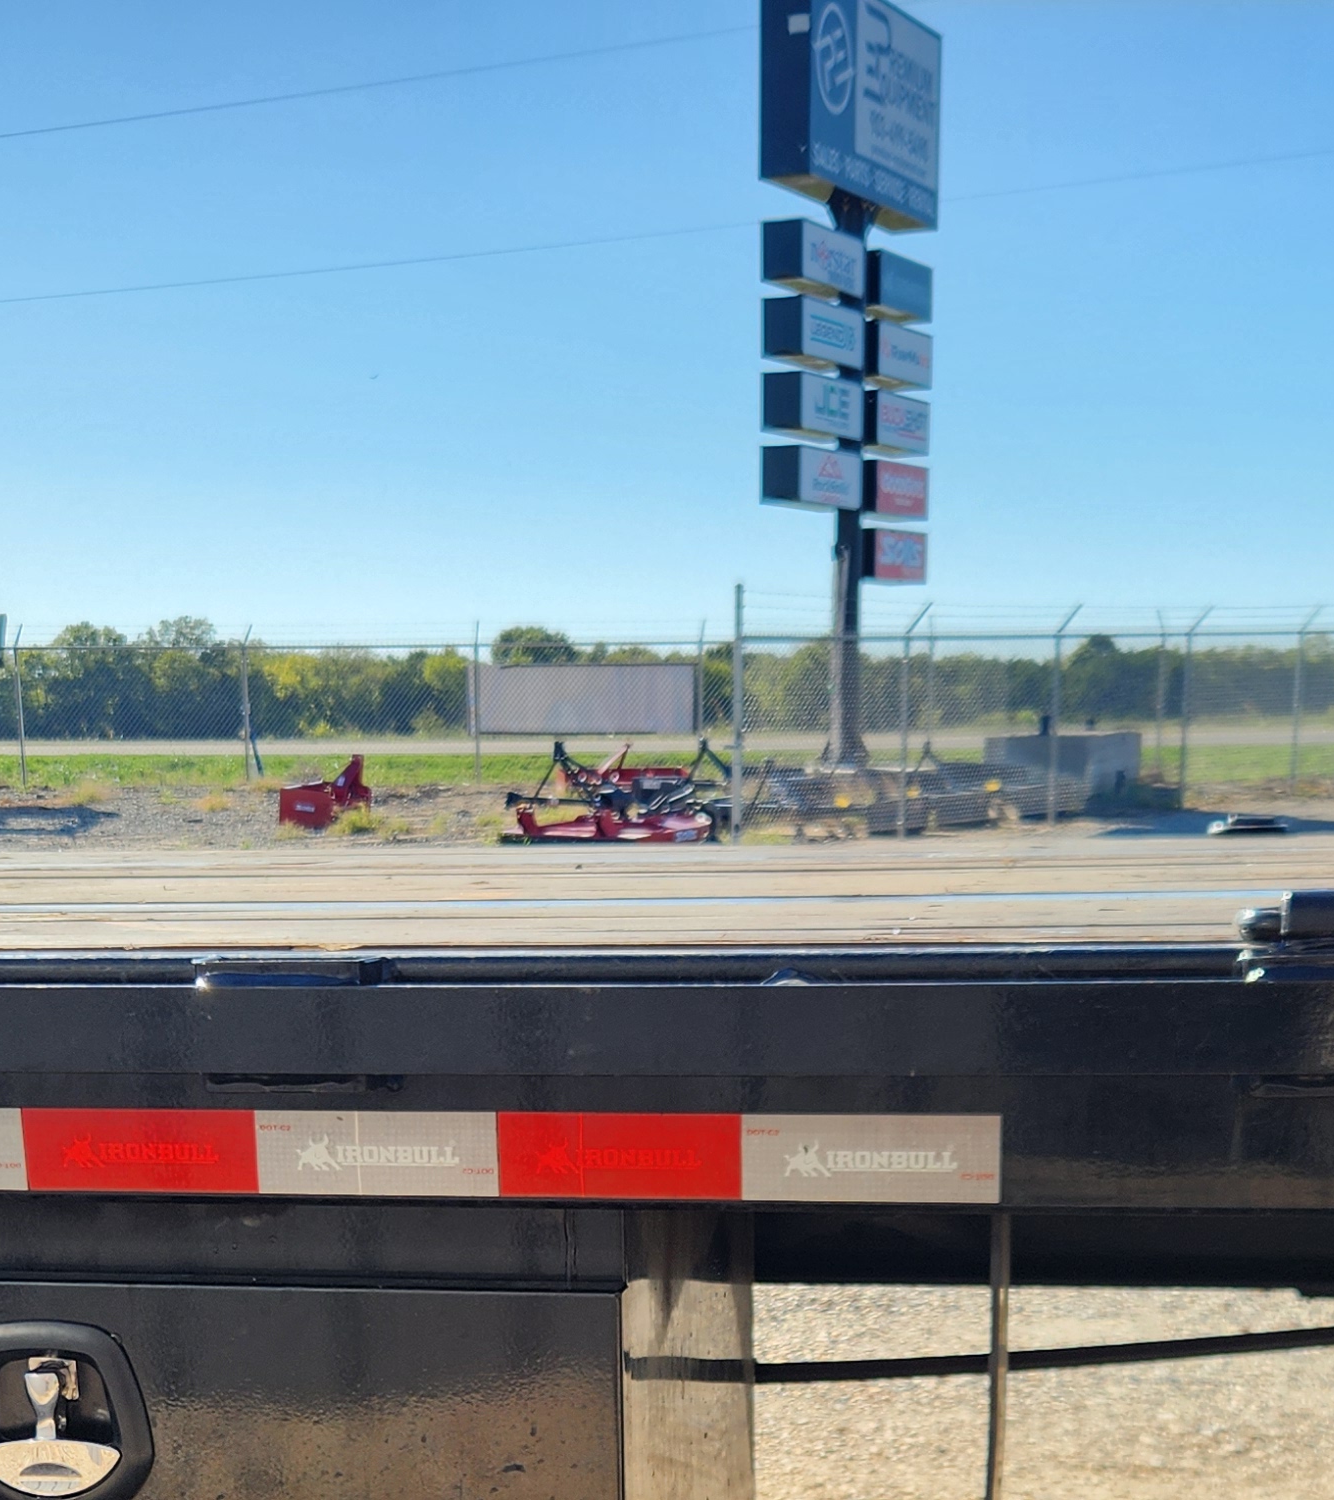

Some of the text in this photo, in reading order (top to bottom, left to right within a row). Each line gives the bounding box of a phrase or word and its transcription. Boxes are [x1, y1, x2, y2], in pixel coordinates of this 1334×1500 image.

[99, 1143, 218, 1161] IRONBULL
[336, 1145, 460, 1164] IRONBULL
[826, 1151, 958, 1169] IRONBULL
